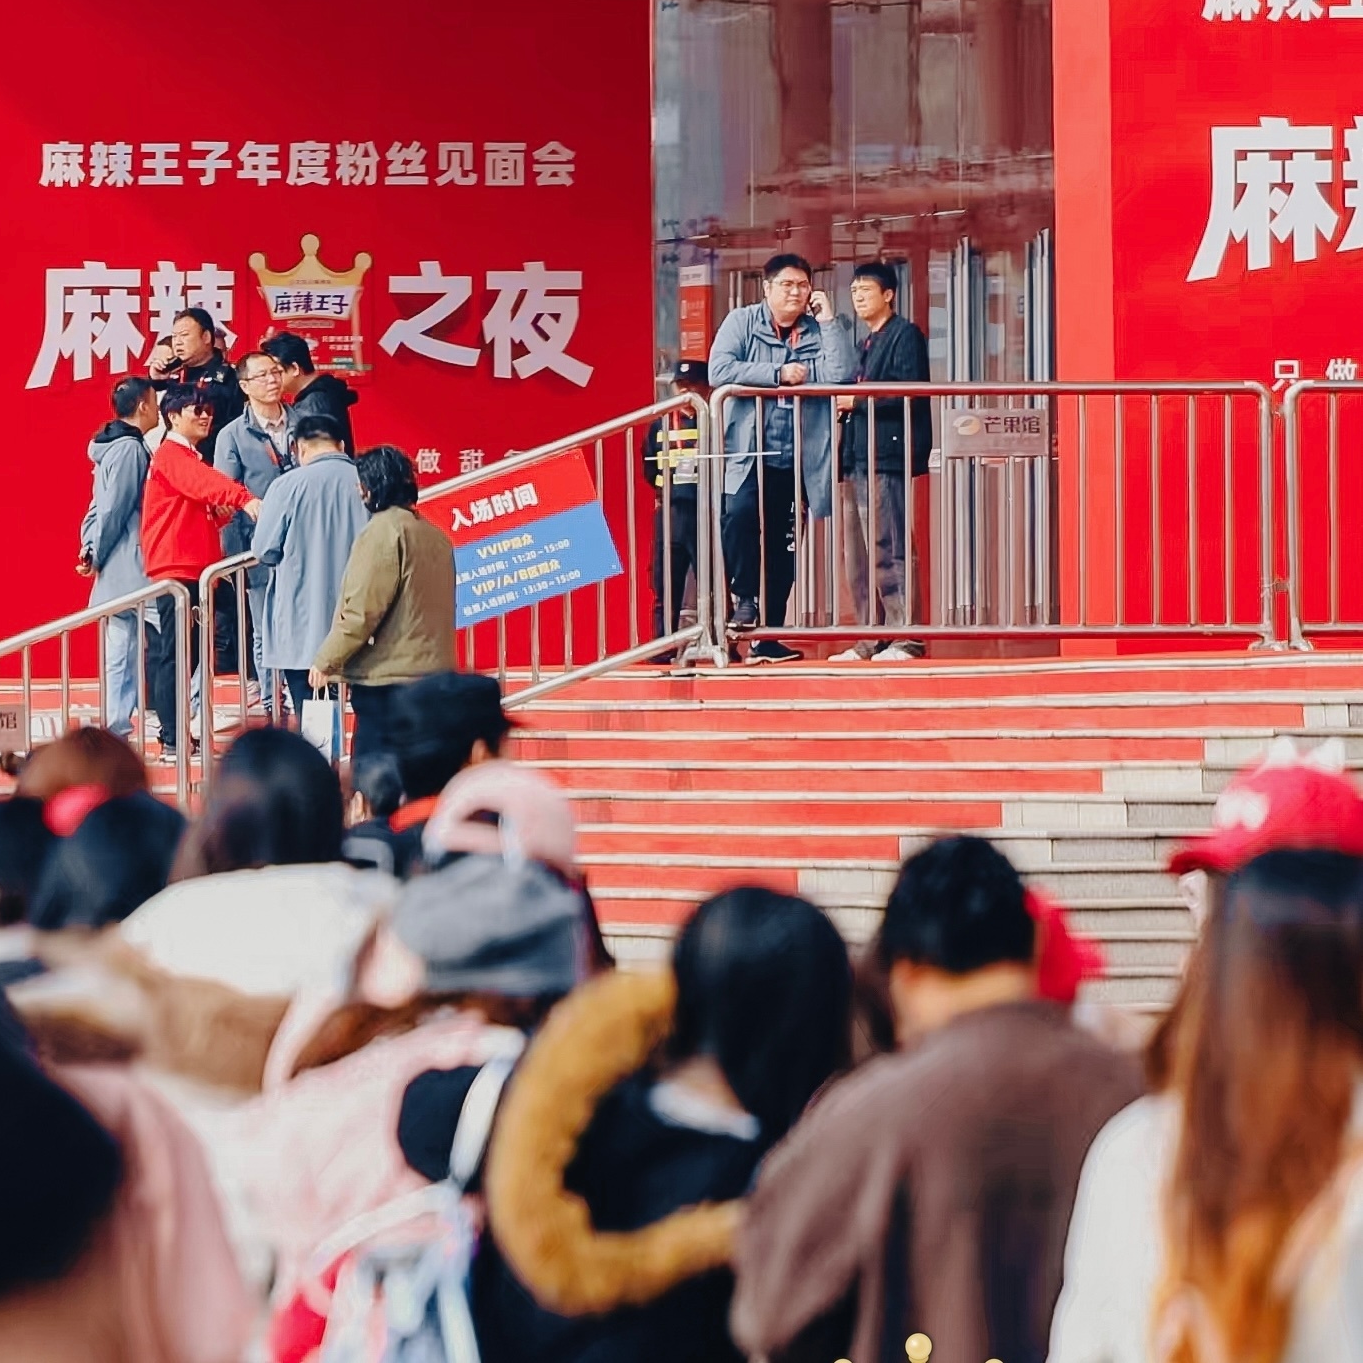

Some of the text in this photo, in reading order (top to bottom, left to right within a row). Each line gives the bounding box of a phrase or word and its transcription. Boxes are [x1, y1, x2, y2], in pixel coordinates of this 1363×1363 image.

[39, 140, 575, 188] 麻辣王子年度粉丝见面会
[25, 261, 594, 389] 麻辣 之夜
[274, 291, 349, 315] 麻辣王子
[984, 416, 1040, 434] 芒果馆
[451, 483, 538, 531] 入场时间
